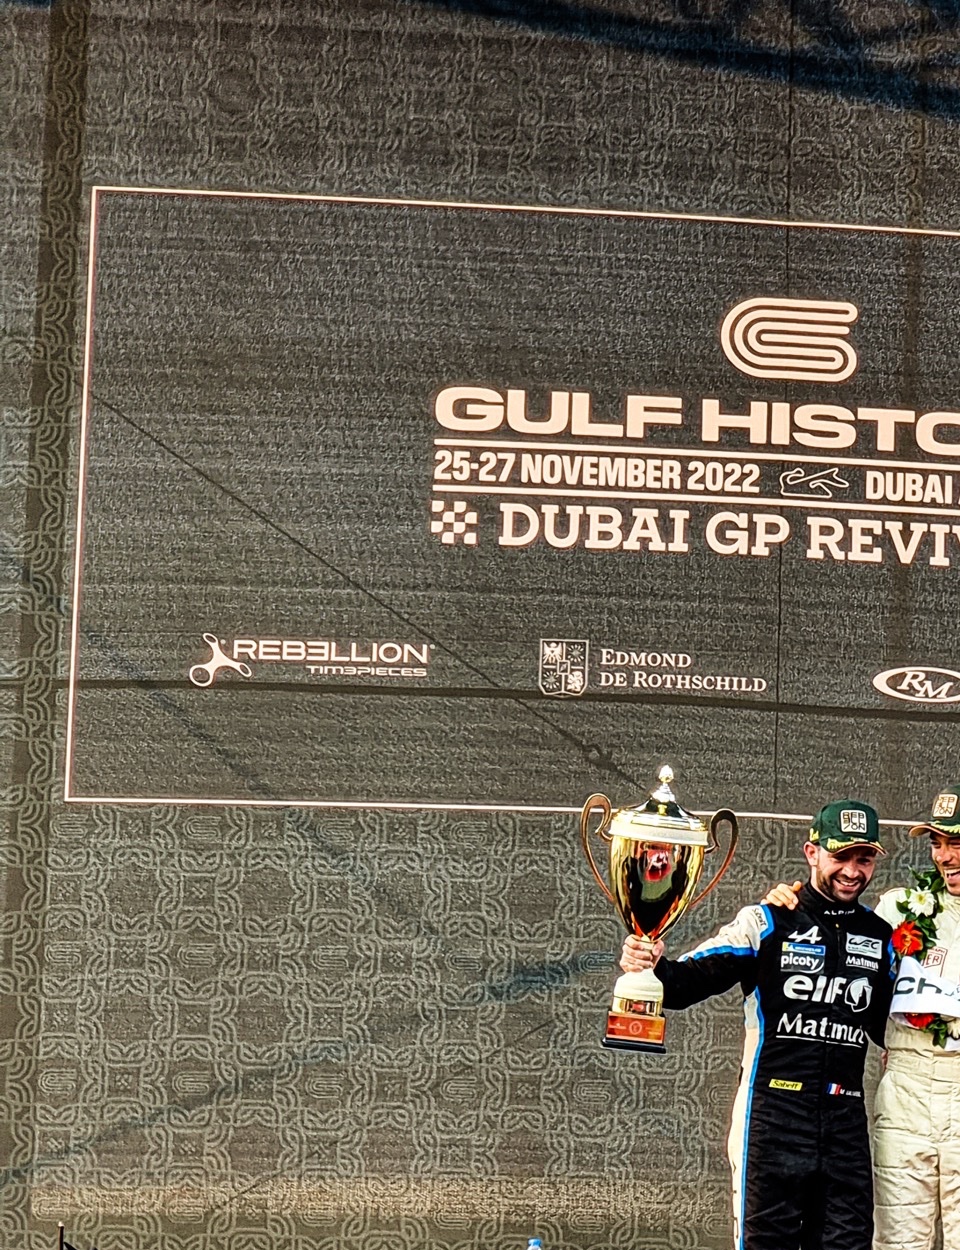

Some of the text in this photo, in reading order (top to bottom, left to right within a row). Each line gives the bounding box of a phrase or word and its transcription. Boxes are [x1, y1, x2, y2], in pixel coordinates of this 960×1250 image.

[434, 385, 684, 439] GULF
[433, 449, 516, 482] 25-27
[520, 453, 682, 490] NOVEMBER
[686, 460, 760, 494] 2022
[865, 470, 953, 505] DUBAI
[498, 502, 690, 553] DUBAI
[705, 511, 790, 557] GP
[599, 670, 767, 692] DE ROTHSCHILD
[780, 952, 820, 971] picoty
